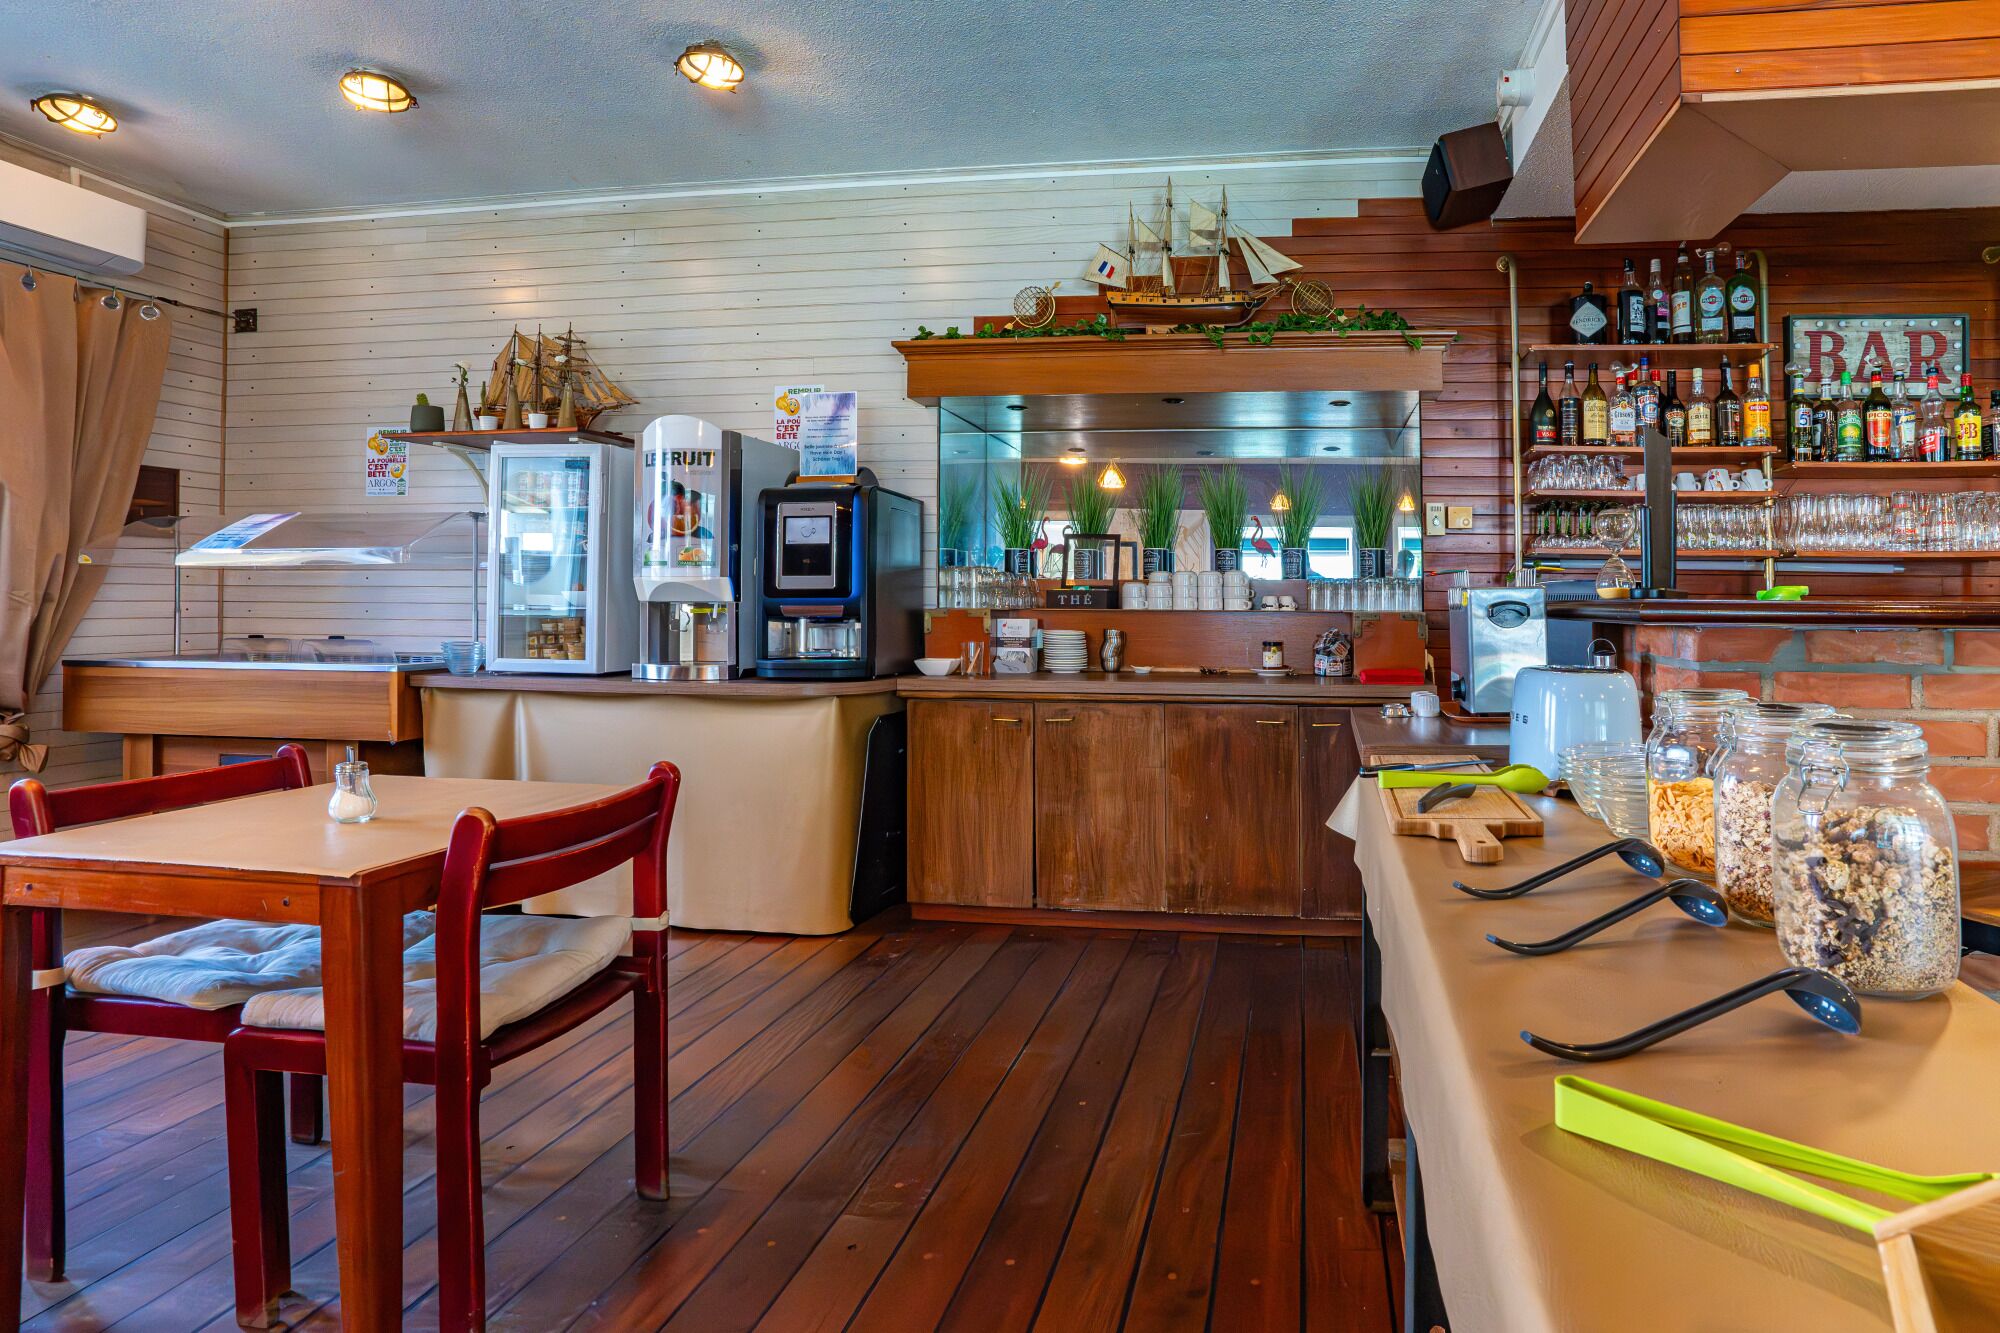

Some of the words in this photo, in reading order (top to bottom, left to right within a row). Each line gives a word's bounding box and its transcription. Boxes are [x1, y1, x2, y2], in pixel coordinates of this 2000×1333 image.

[1804, 330, 1953, 384] BAR
[776, 425, 801, 433] C'EST
[1957, 422, 1978, 440] J&B
[367, 479, 397, 488] ARGOS
[1057, 593, 1092, 605] THÉ
